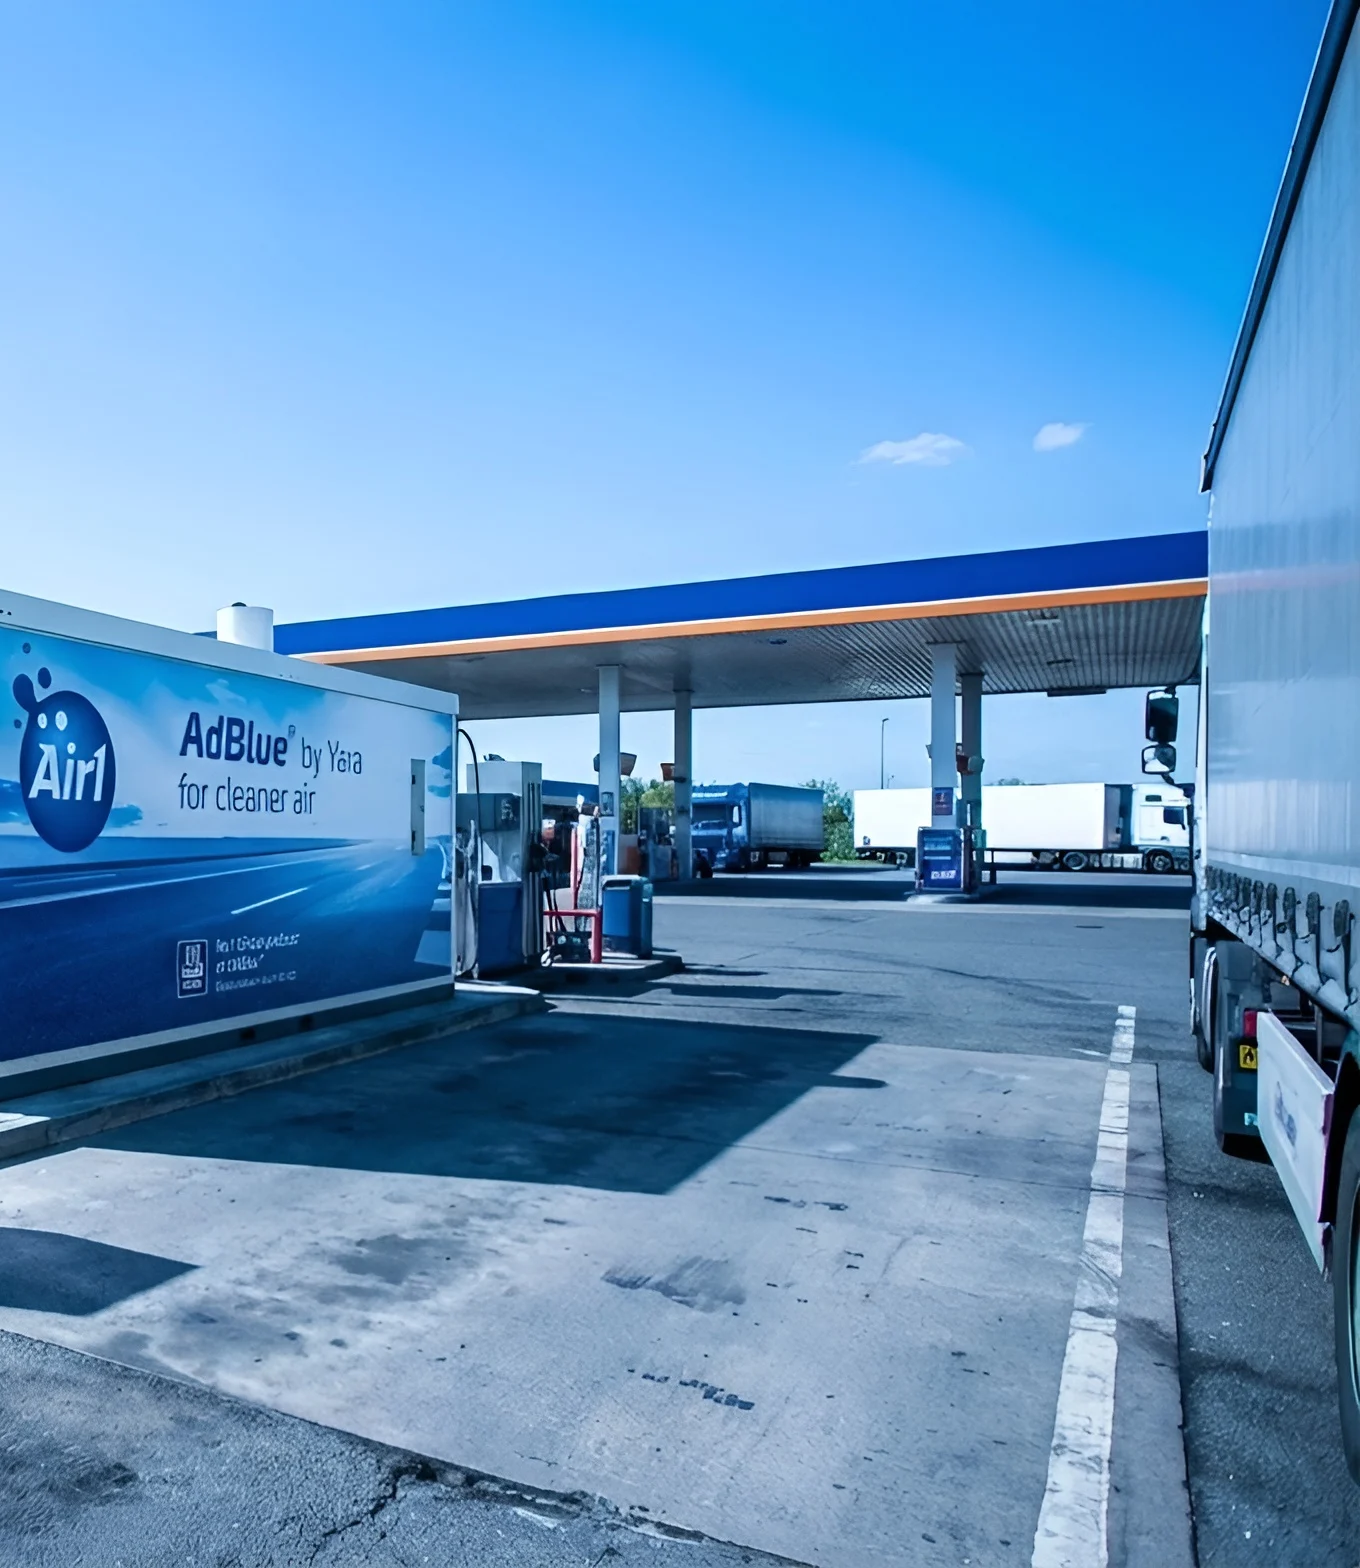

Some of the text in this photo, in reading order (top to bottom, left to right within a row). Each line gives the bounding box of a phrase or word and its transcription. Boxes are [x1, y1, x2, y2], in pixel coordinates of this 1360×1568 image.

[28, 742, 107, 802] Air1
[301, 736, 322, 779] by
[178, 772, 316, 815] for cleaner air
